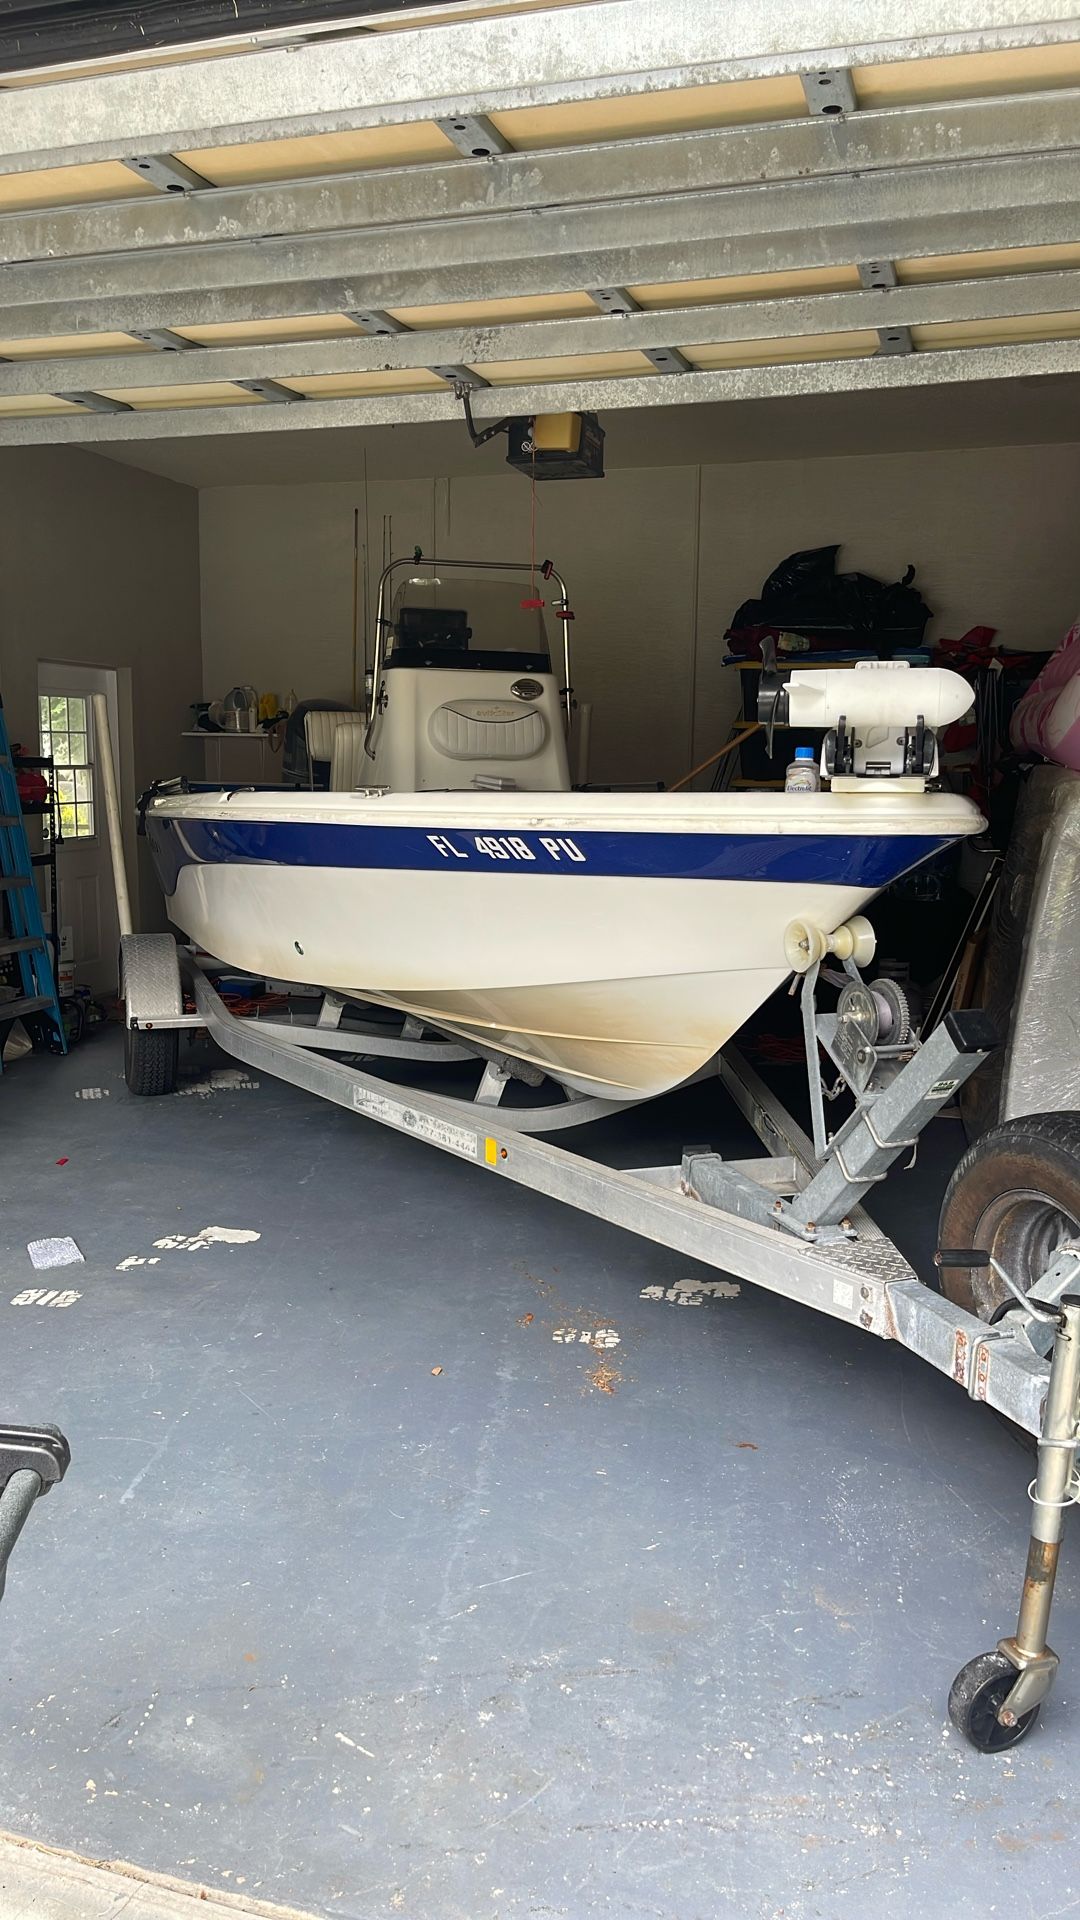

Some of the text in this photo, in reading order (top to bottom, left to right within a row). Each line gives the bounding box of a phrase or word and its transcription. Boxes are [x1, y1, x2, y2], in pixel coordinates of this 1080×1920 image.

[426, 835, 586, 862] FL 4918 PU
